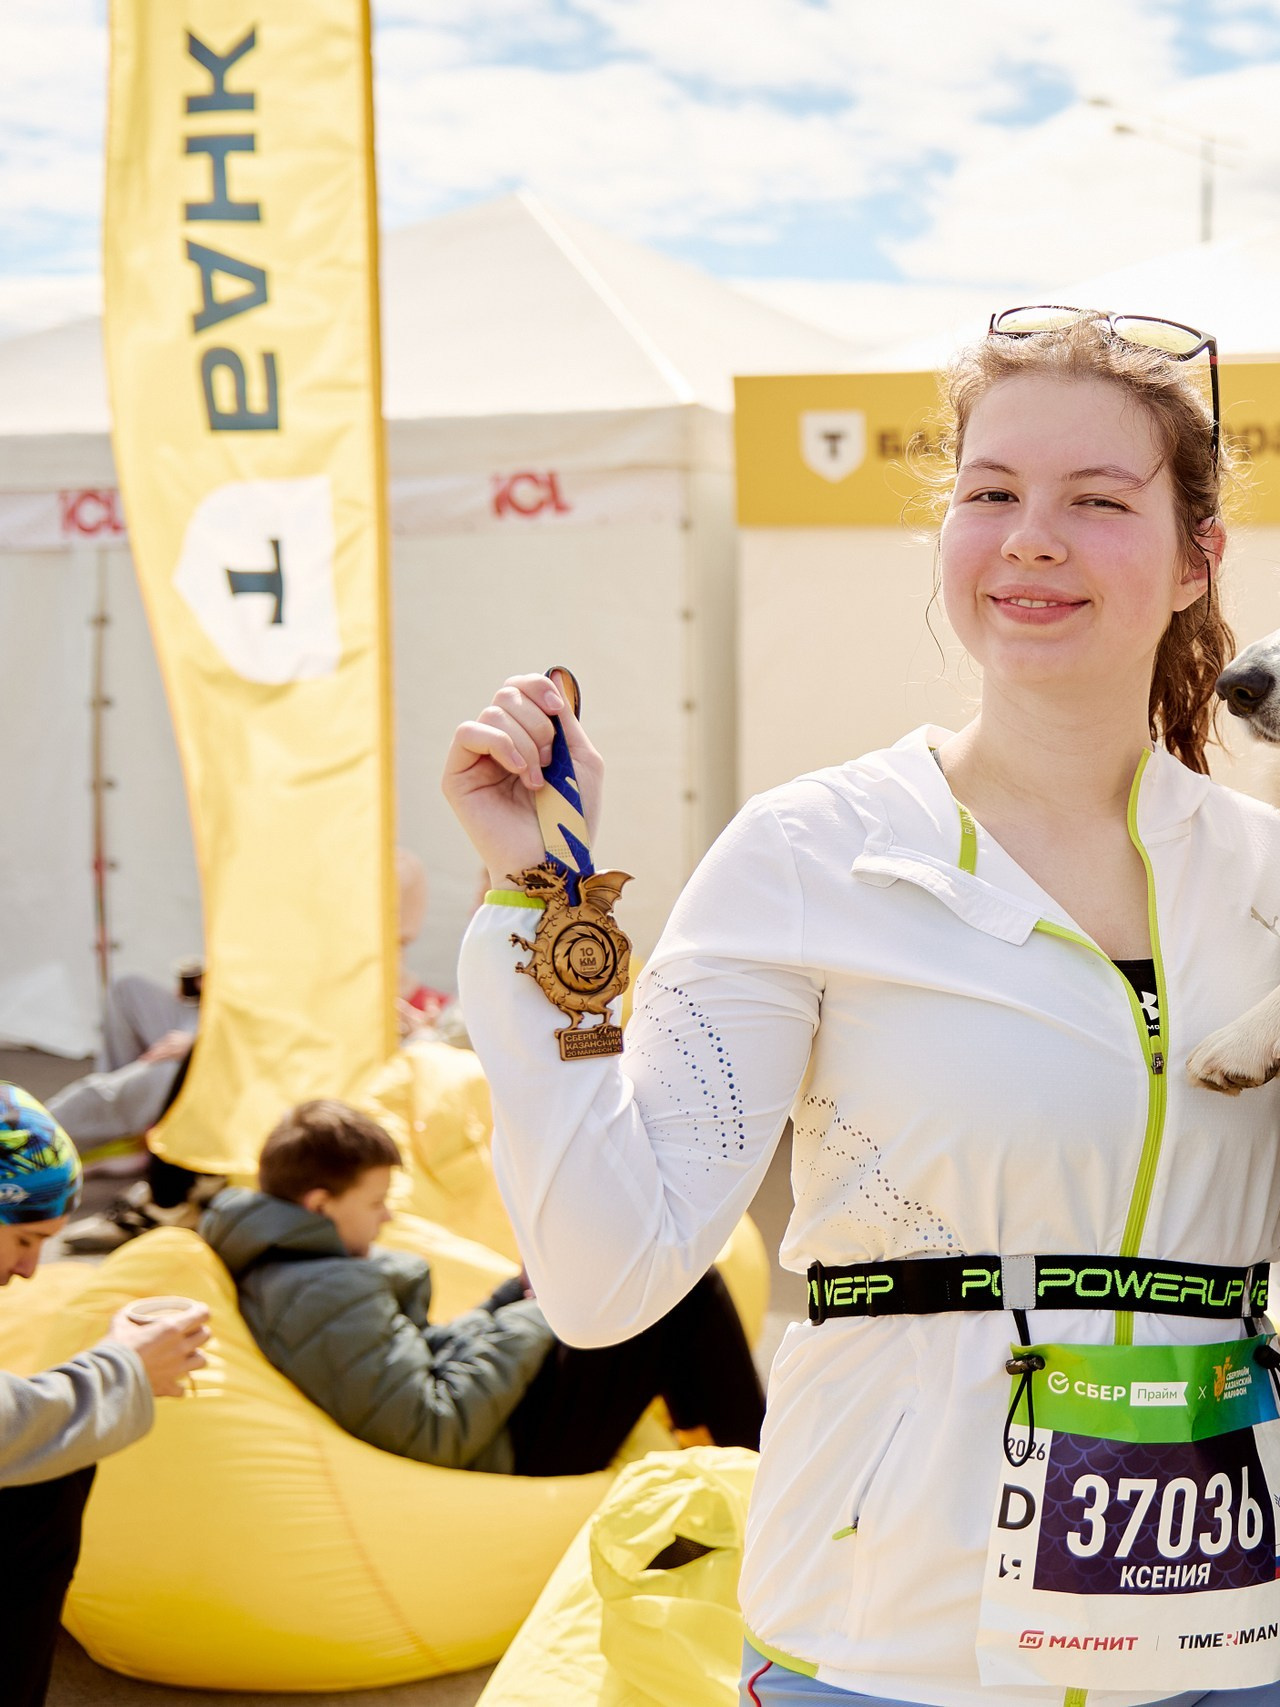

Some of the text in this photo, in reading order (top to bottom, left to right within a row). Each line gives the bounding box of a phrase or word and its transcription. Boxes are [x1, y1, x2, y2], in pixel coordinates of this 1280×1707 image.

[580, 947, 594, 957] 10
[1037, 1268, 1244, 1307] POWERUP
[1074, 1380, 1127, 1402] СБЕР
[1137, 1387, 1178, 1402] Прайм
[1006, 1437, 1047, 1461] 2026
[997, 1482, 1036, 1531] D
[1065, 1466, 1263, 1559] 37036
[1119, 1561, 1212, 1589] КСЕНИЯ
[1049, 1634, 1139, 1651] МАГНИТ
